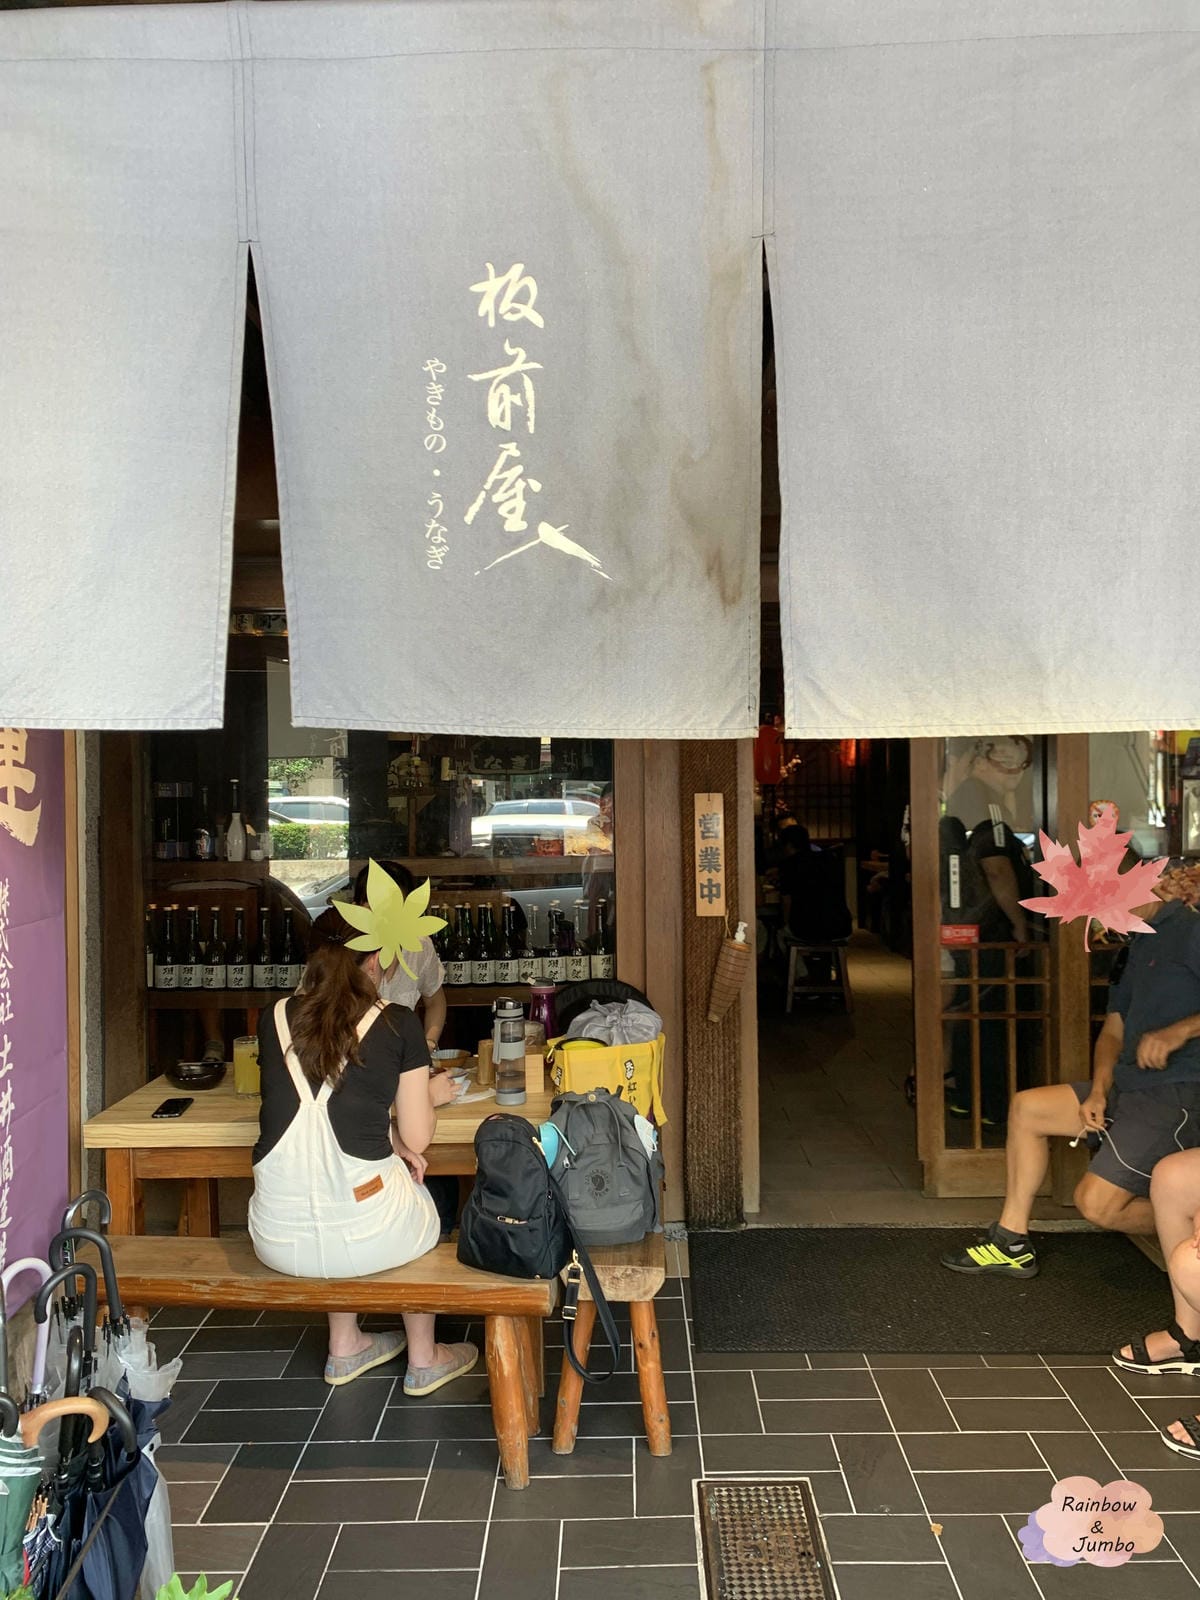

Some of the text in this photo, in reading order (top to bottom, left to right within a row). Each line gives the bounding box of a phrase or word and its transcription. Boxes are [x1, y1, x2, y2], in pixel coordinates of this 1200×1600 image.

[422, 358, 449, 570] やきもの・うなぎ
